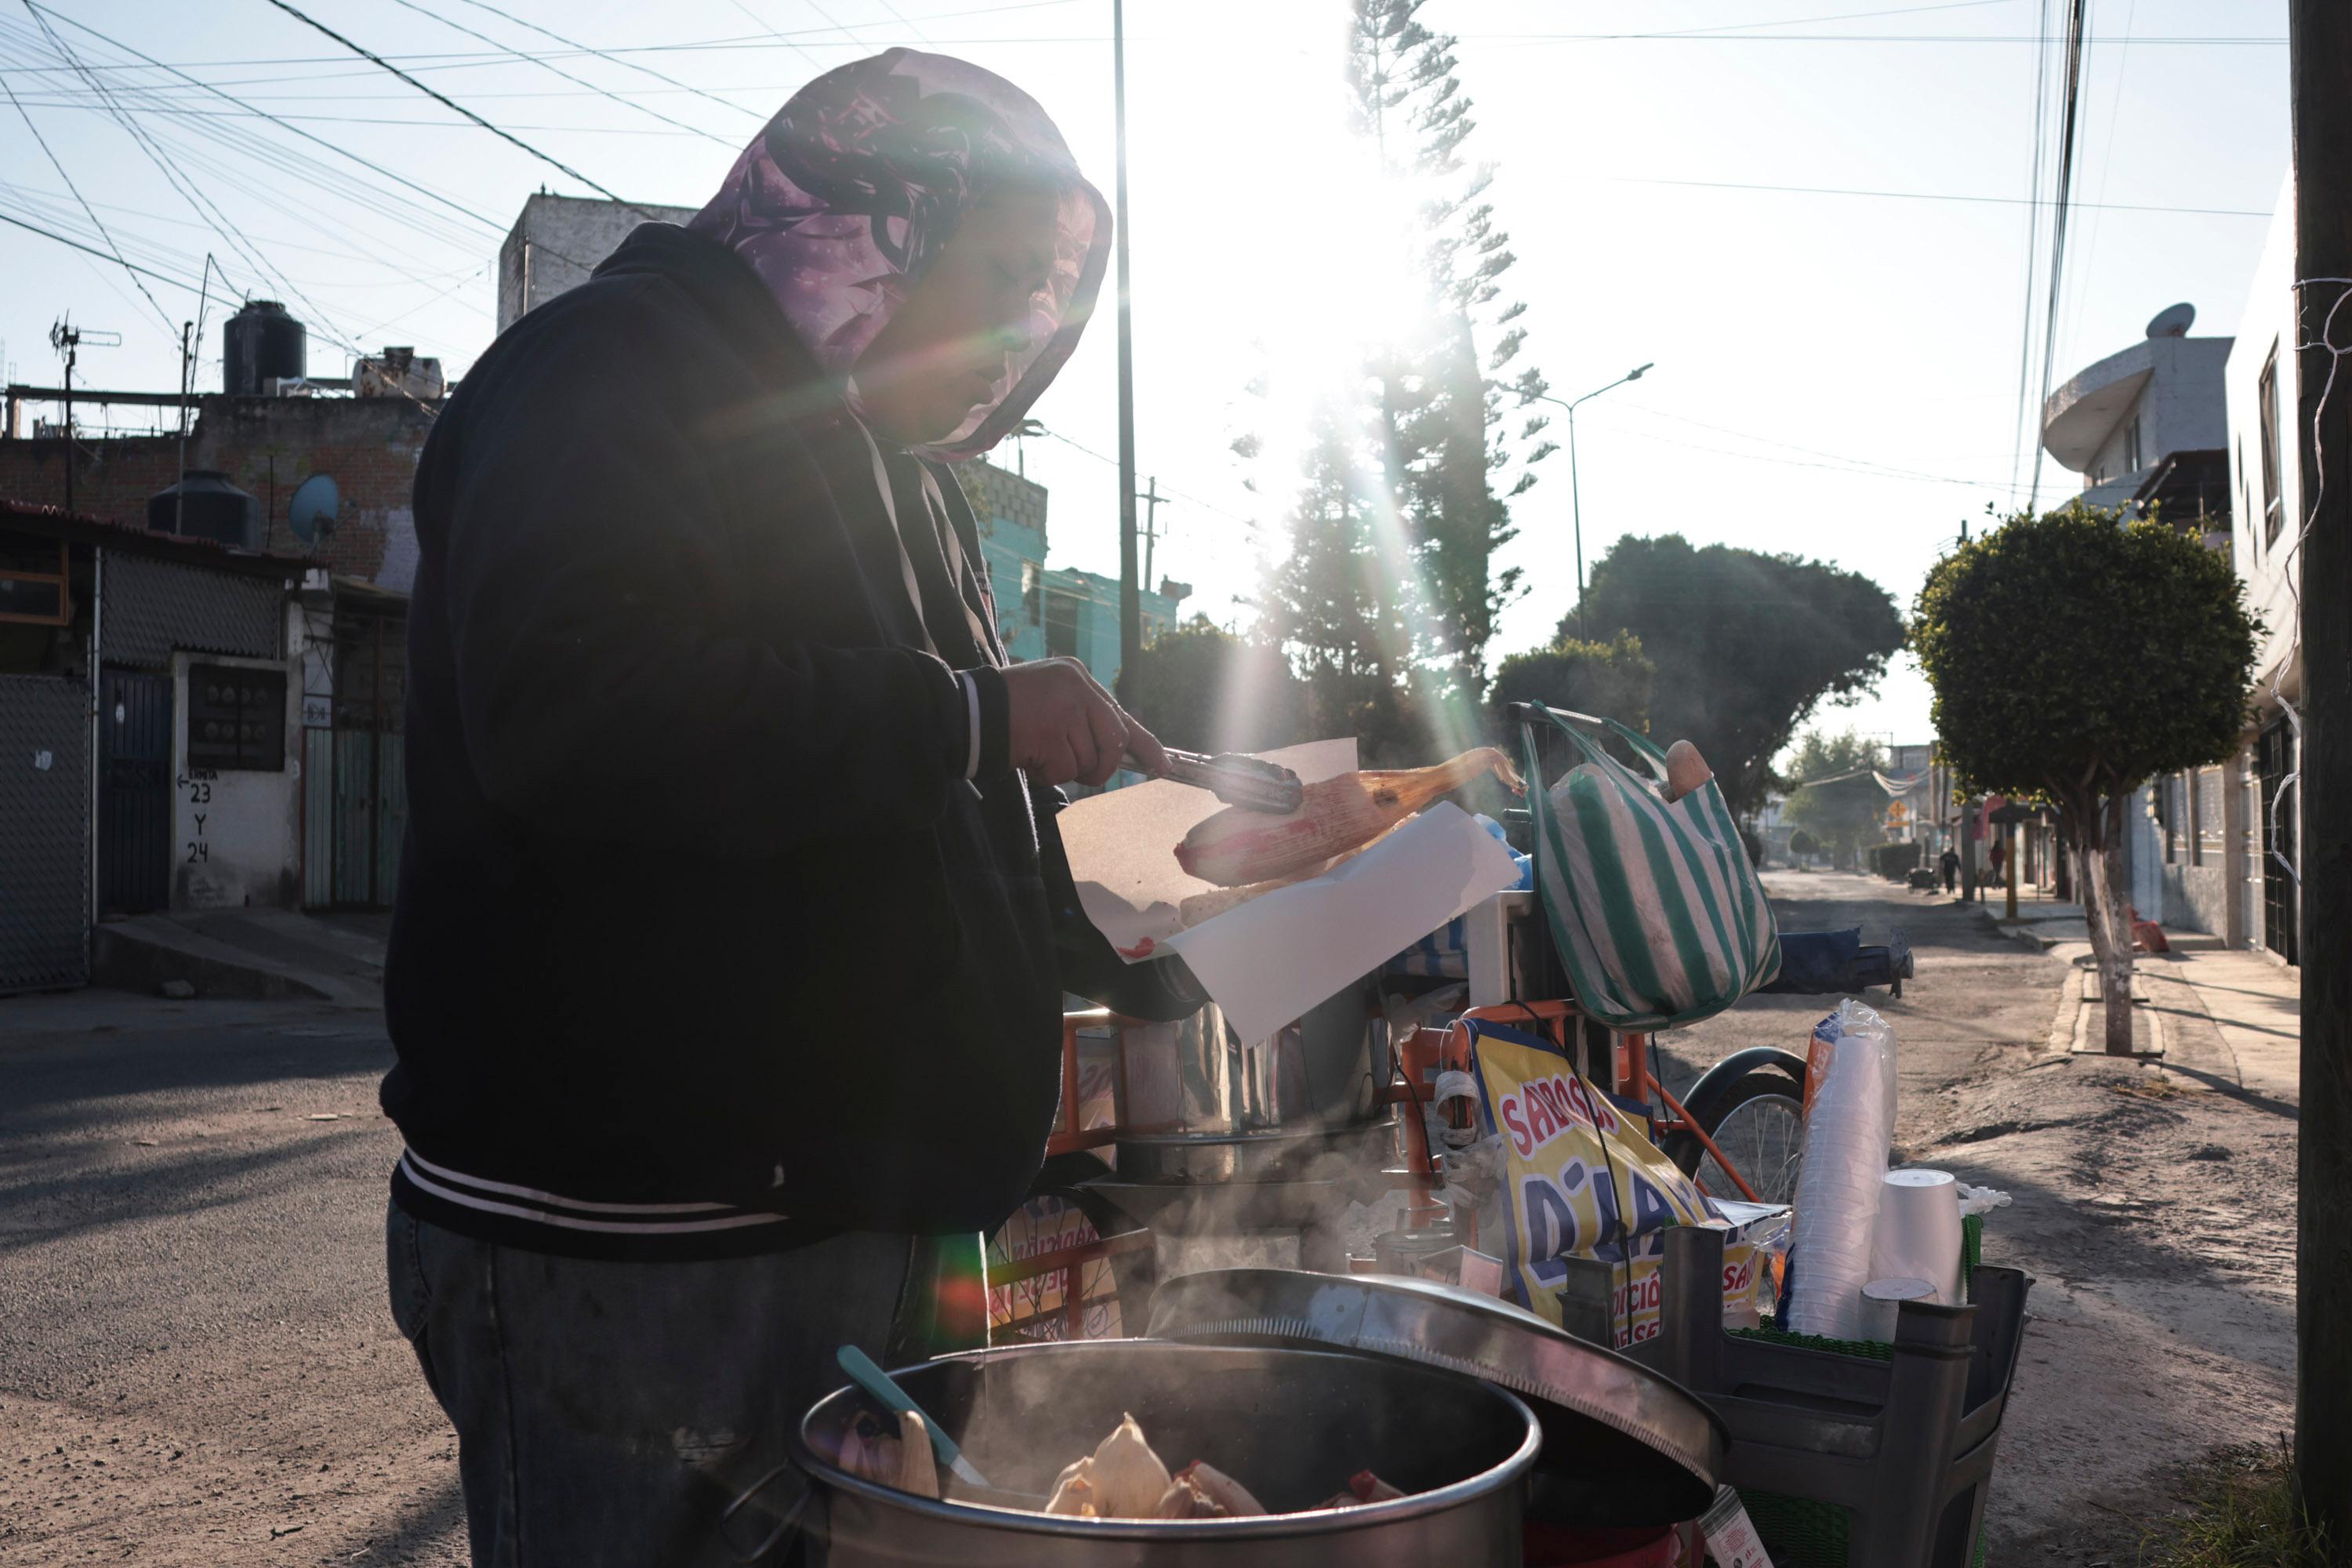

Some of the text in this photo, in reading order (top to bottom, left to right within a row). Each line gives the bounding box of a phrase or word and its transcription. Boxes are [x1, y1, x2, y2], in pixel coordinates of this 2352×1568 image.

[191, 783, 211, 804] 23
[194, 814, 206, 836] Y
[187, 842, 208, 863] 24
